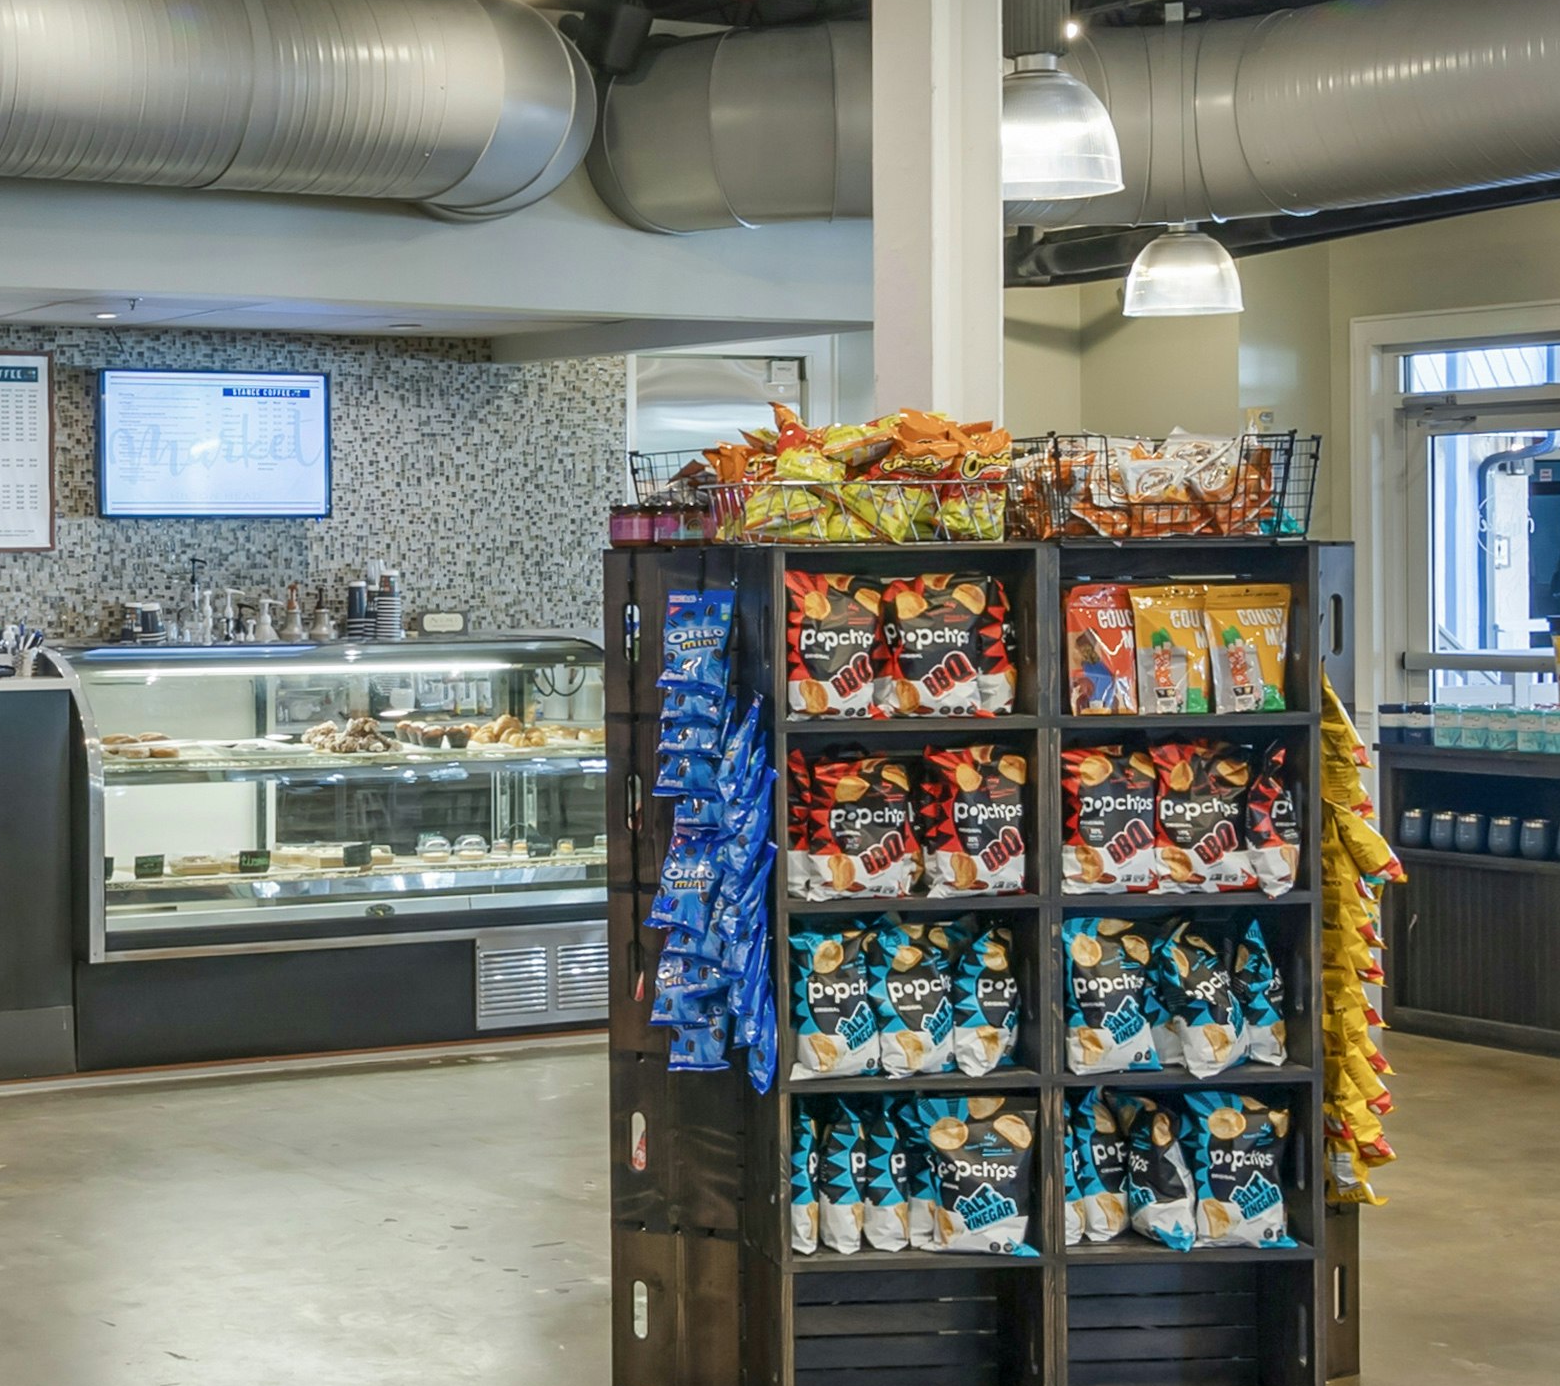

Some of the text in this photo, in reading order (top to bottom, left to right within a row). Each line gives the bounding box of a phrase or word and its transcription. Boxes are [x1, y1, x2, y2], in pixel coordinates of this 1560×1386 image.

[668, 629, 725, 643] OREO
[681, 639, 719, 650] mini
[921, 651, 977, 699] BBQ
[954, 802, 1022, 825] popchips
[1080, 794, 1154, 816] popchips
[979, 825, 1025, 873] BBQ
[1104, 817, 1155, 864] BBQ
[1193, 819, 1239, 865] BBQ
[1210, 1149, 1275, 1172] popchips
[960, 1187, 992, 1218] SALT
[964, 1200, 1015, 1231] VINEGAR
[1241, 1188, 1281, 1219] VINEGAR
